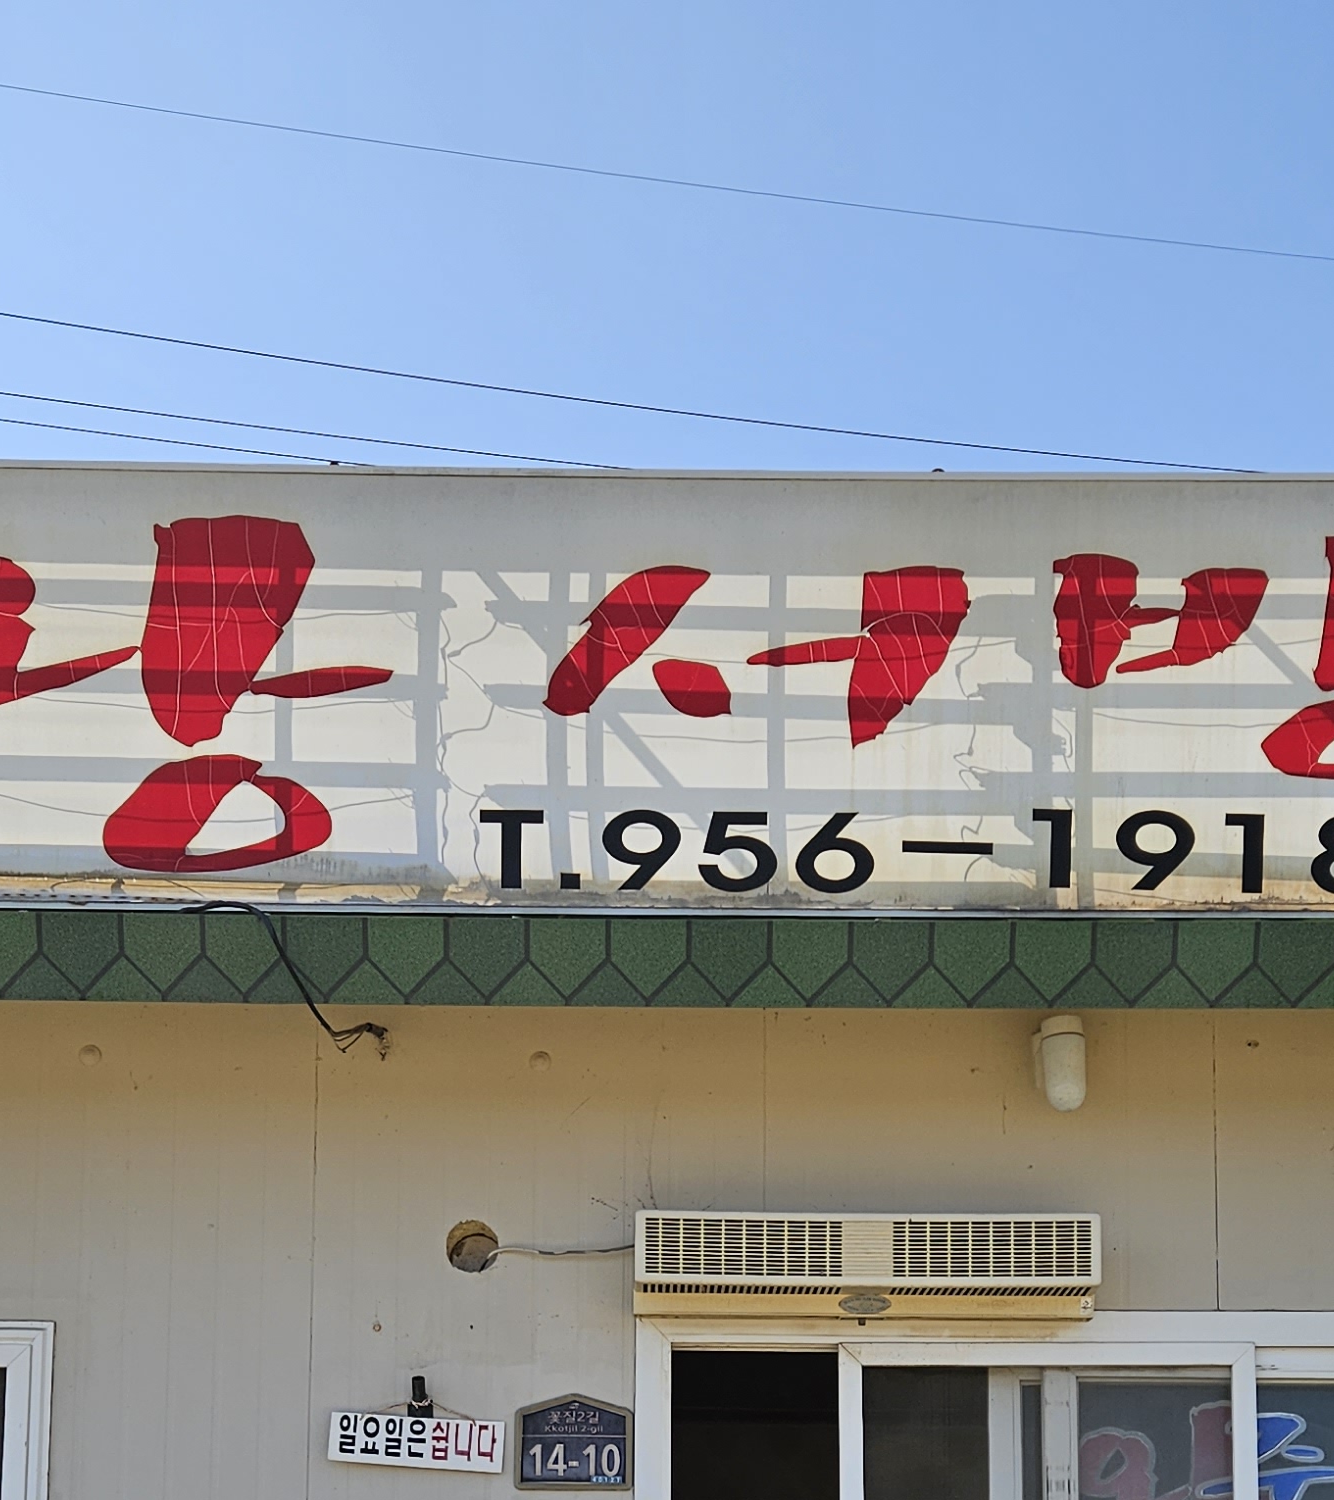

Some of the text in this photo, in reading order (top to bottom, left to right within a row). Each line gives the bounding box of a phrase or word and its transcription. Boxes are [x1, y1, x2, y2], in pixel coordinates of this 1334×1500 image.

[548, 1411, 599, 1424] 꽃질2길
[544, 1425, 603, 1434] Kkotjil 2-gil
[529, 1443, 621, 1477] 14-10
